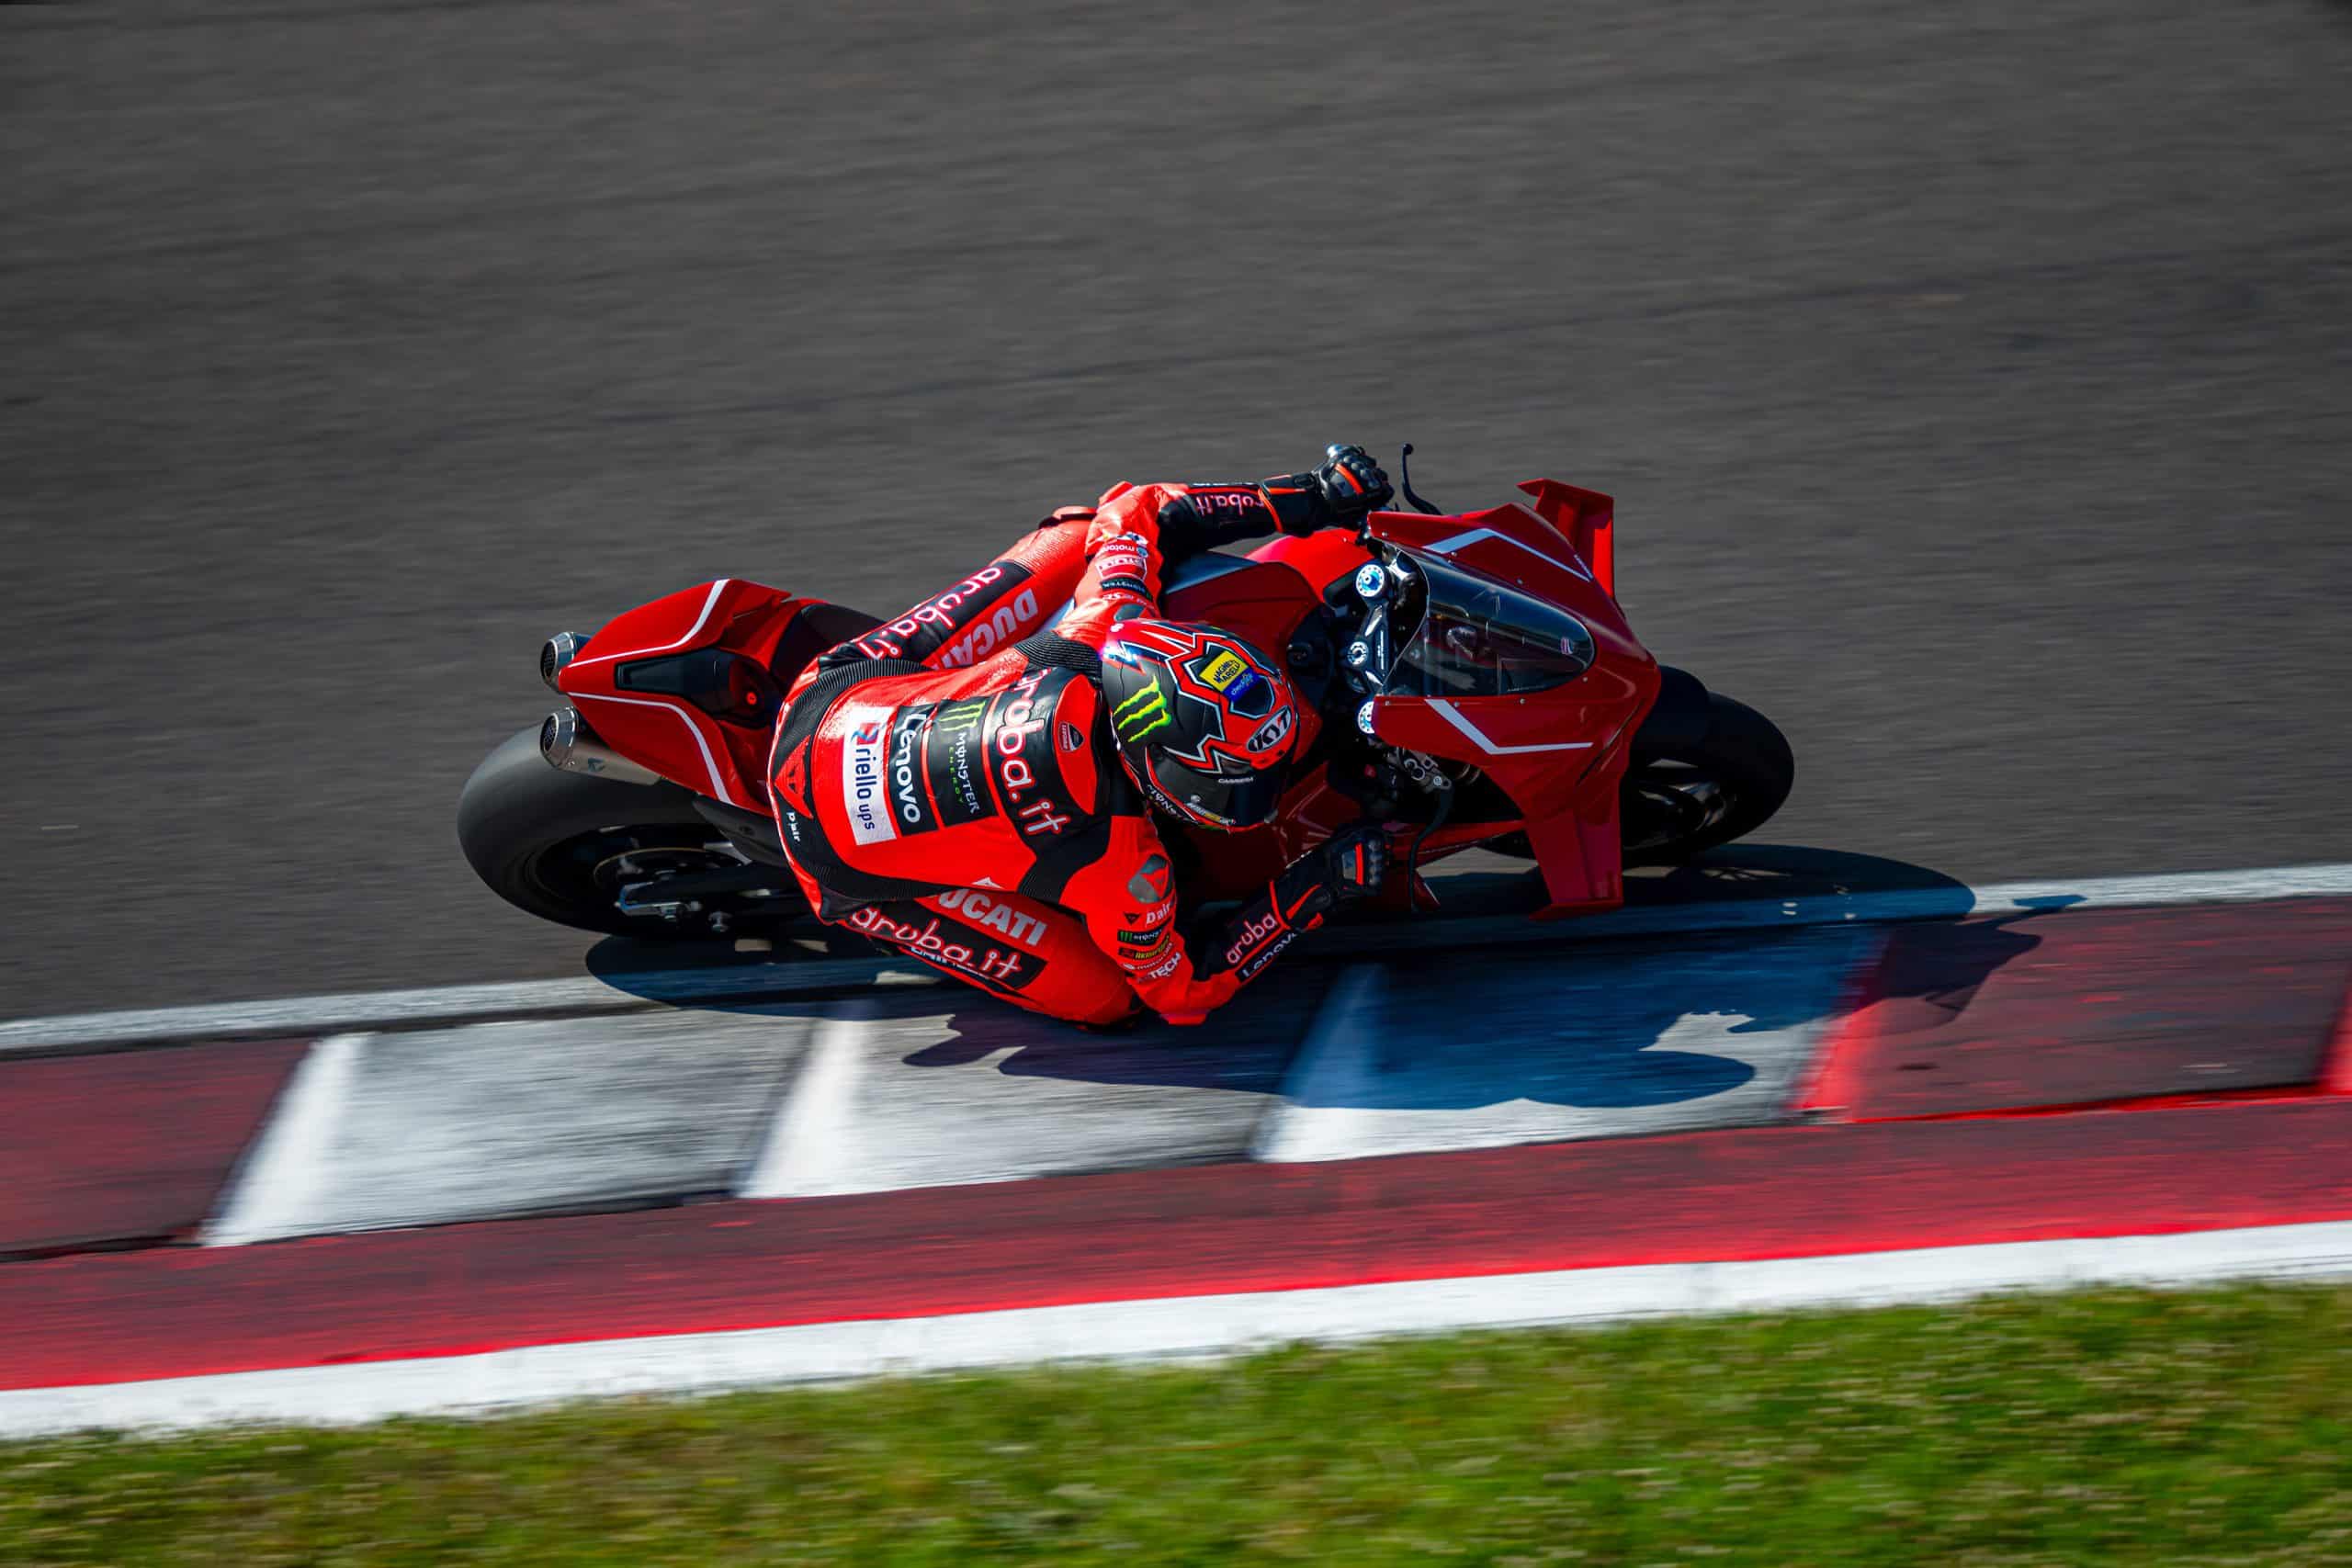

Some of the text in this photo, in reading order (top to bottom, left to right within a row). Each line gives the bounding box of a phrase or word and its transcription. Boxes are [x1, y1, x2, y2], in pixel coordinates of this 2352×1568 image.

[1195, 493, 1265, 516] ruba.it
[931, 586, 1039, 671] DUCA
[854, 747, 877, 830] riello ups
[895, 712, 928, 824] Lenovo
[851, 905, 1022, 980] aruba.it
[937, 887, 1047, 946] UCATI
[1241, 932, 1297, 978] Lenov
